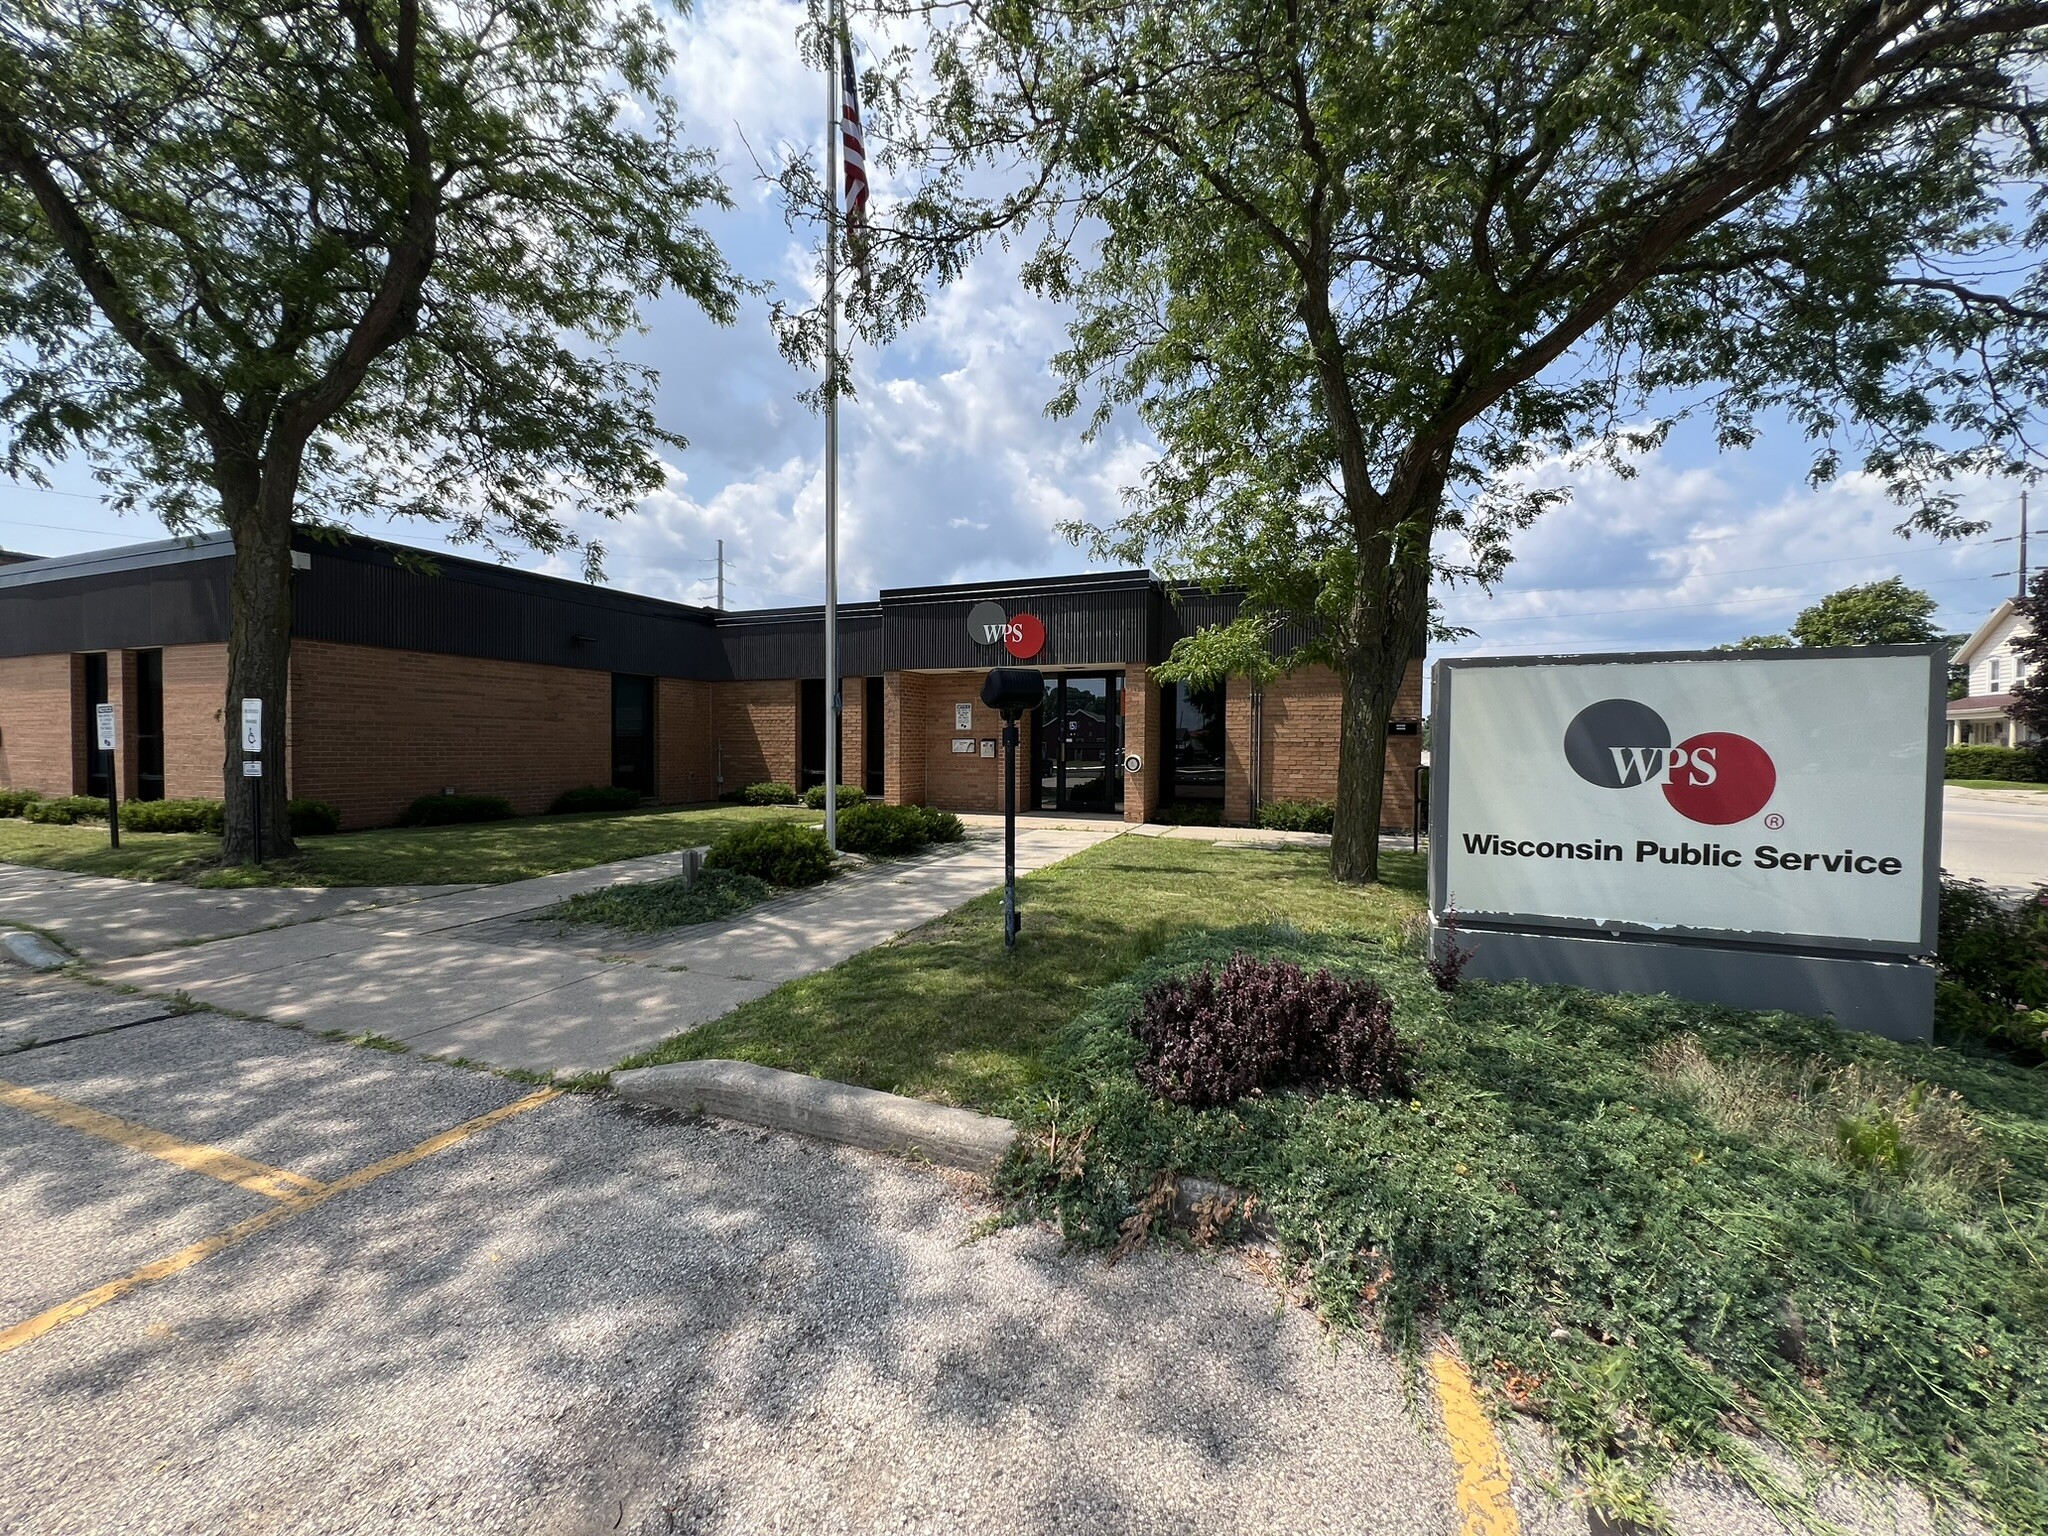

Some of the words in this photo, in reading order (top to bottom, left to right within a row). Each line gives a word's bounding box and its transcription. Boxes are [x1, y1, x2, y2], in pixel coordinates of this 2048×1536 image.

[983, 623, 1023, 643] WPS
[1608, 746, 1718, 786] WPS
[1463, 833, 1623, 861] Wisconsin
[1636, 840, 1742, 867] Public
[1754, 846, 1902, 875] Service
